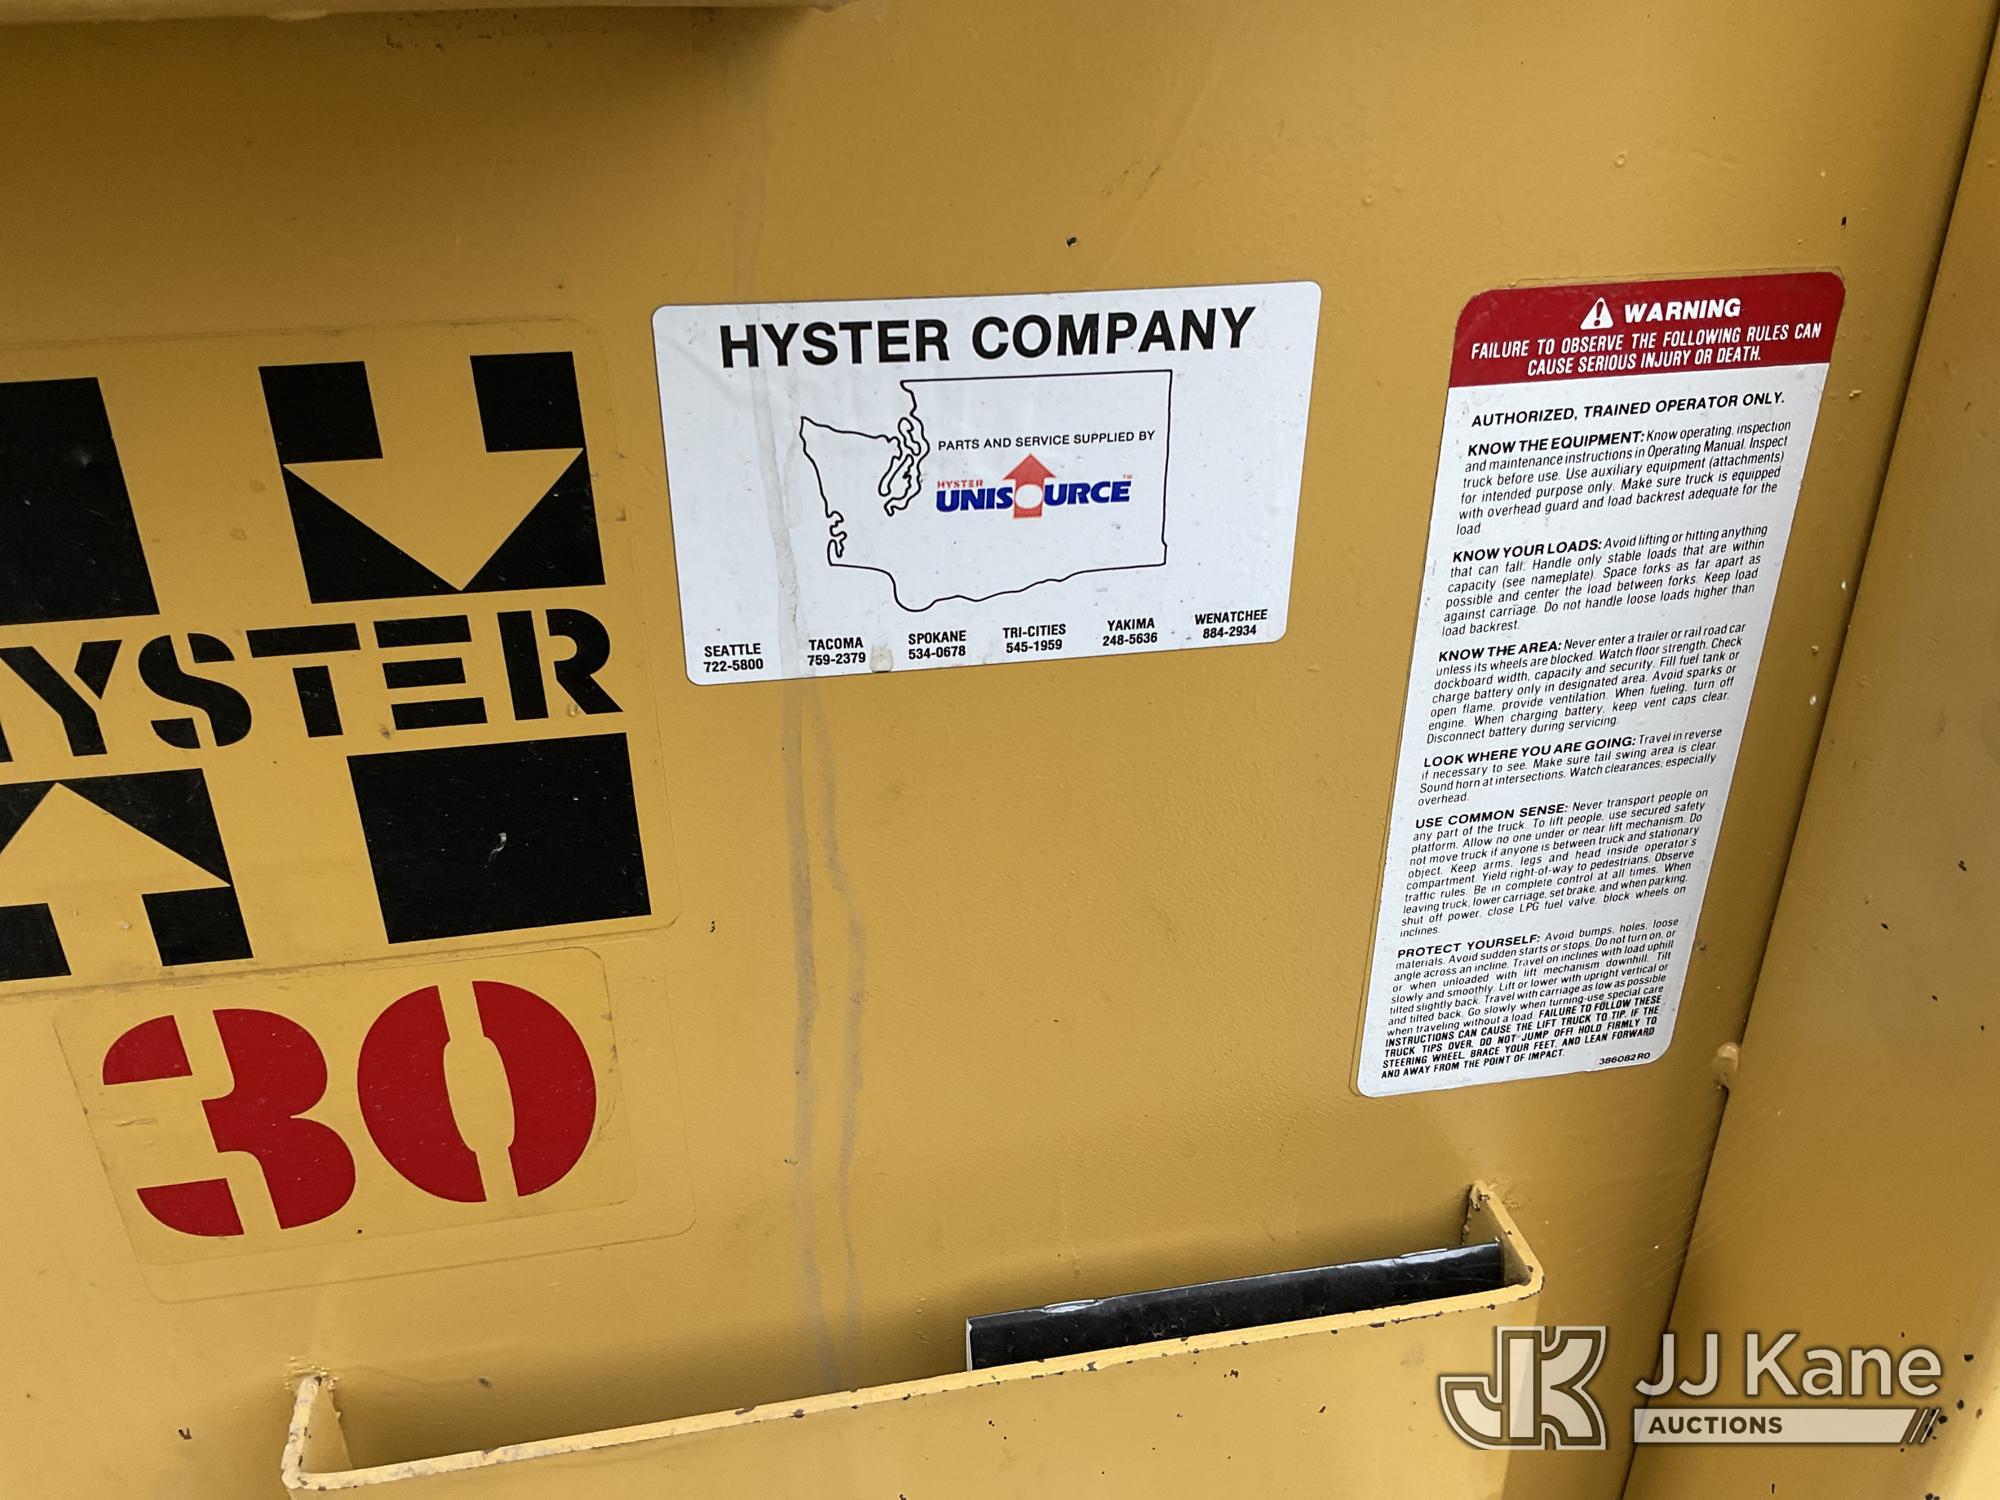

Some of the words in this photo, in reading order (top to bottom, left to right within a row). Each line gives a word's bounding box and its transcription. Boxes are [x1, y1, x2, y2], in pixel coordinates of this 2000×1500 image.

[1624, 297, 1741, 323] WARNING
[719, 318, 951, 369] HYSTER
[971, 306, 1257, 360] COMPANY
[1471, 339, 1530, 359] FAILURE
[1537, 338, 1555, 355] TO
[1560, 334, 1624, 354] OBSERVE
[1631, 332, 1657, 349] THE
[1662, 326, 1741, 347] FOLLOWING
[1746, 324, 1789, 342] RULES
[1794, 322, 1822, 339] CAN
[1527, 356, 1574, 376] CAUSE
[1577, 353, 1637, 373] SERIOUS
[1640, 349, 1691, 368] INJURY
[1694, 348, 1713, 365] OR
[1716, 345, 1761, 363] DEATH.
[1471, 407, 1577, 427] AUTHORIZED,
[1583, 401, 1651, 418] TRAINED
[1655, 394, 1738, 413] OPERATOR
[1742, 391, 1783, 406] ONLY.
[938, 440, 979, 451] PARTS
[983, 438, 1011, 449] AND
[1015, 435, 1070, 447] SERVICE
[1074, 431, 1135, 444] SUPPLIED
[1138, 430, 1155, 441] BY
[1467, 440, 1516, 457] KNOW
[1518, 437, 1549, 452] THE
[1550, 430, 1645, 450] EQUIPMENT:
[1646, 429, 1678, 442] Know
[1736, 420, 1791, 436] inspection
[936, 481, 1132, 512] UNISOURCE
[937, 480, 984, 489] HYSTER
[1460, 492, 1477, 504] for
[1481, 486, 1532, 502] intended
[1535, 484, 1583, 500] purpose
[1620, 476, 1652, 490] Make
[1656, 476, 1681, 488] sure
[1685, 471, 1714, 485] truck
[1717, 472, 1728, 482] is
[1731, 465, 1781, 483] equipped
[1458, 506, 1483, 520] with
[1487, 501, 1542, 518] overhead
[1544, 498, 1579, 515] guard
[1582, 495, 1604, 509] and
[1607, 493, 1633, 507] load
[1635, 489, 1685, 504] backrest
[1687, 485, 1739, 500] adequate
[1742, 483, 1758, 495] for
[1760, 481, 1778, 494] the
[1452, 547, 1500, 563] KNOW
[1502, 543, 1545, 558] YOUR
[1546, 538, 1602, 555] LOADS:
[1603, 535, 1637, 549] Avoid
[1638, 533, 1670, 547] lifting
[1671, 533, 1683, 543] or
[1684, 529, 1719, 542] hitting
[1720, 525, 1768, 540] anything
[1107, 617, 1155, 632] YAKIMA
[1194, 608, 1268, 626] WENATCHEE
[1441, 623, 1466, 636] load
[808, 637, 864, 651] TACOMA
[908, 630, 967, 645] SPOKANE
[1003, 624, 1067, 639] TRI-CITIES
[1102, 632, 1158, 647] 248-5636
[1202, 625, 1257, 639] 884-2934
[1438, 647, 1485, 662] KNOW
[1487, 644, 1517, 657] THE
[1517, 640, 1562, 655] AREA:
[1563, 638, 1596, 650] Never
[1597, 635, 1626, 647] enter
[1627, 634, 1635, 644] a
[1636, 630, 1669, 643] trailer
[1670, 630, 1682, 639] or
[1683, 625, 1702, 638] rail
[1703, 623, 1728, 636] road
[1728, 623, 1746, 634] car
[704, 643, 761, 658] SEATTLE
[807, 652, 866, 667] 759-2379
[908, 645, 967, 660] 534-0678
[1006, 639, 1063, 654] 545-1959
[703, 658, 764, 673] 722-5800
[0, 607, 622, 762] YSTER
[1432, 692, 1470, 704] charge
[1473, 687, 1513, 700] battery
[1516, 683, 1541, 696] only
[1544, 683, 1555, 692] in
[1558, 674, 1619, 691] designated
[1651, 668, 1684, 681] Avoid
[1686, 664, 1722, 679] sparks
[1725, 665, 1736, 674] or
[1426, 728, 1485, 744] Disconnect
[1488, 726, 1527, 738] battery
[1530, 722, 1565, 733] during
[1423, 753, 1464, 768] LOOK
[1466, 747, 1518, 763] WHERE
[1521, 744, 1552, 757] YOU
[1552, 741, 1582, 754] ARE
[1584, 736, 1636, 751] GOING:
[1639, 732, 1671, 744] Travel
[1672, 732, 1682, 741] in
[1684, 728, 1722, 740] reverse
[1415, 816, 1443, 829] USE
[1447, 808, 1515, 825] COMMON
[1518, 803, 1568, 818] SENSE:
[1572, 800, 1603, 811] Never
[1606, 793, 1655, 808] transport
[1657, 789, 1692, 804] people
[1695, 789, 1708, 798] on
[1409, 855, 1426, 866] not
[1429, 853, 1458, 863] move
[1460, 848, 1487, 860] truck
[1490, 846, 1498, 857] if
[1499, 844, 1539, 857] anyone
[1540, 843, 1550, 851] is
[1552, 838, 1596, 850] between
[1598, 833, 1625, 845] truck
[1626, 830, 1647, 842] and
[1648, 826, 1700, 839] stationary
[1397, 942, 1462, 959] PROTECT
[1466, 933, 1540, 951] YOURSELF:
[1544, 929, 1574, 942] Avoid
[1652, 918, 1679, 928] loose
[1392, 985, 1402, 993] or
[1409, 981, 1437, 990] when
[1442, 973, 1489, 987] unloaded
[1495, 970, 1517, 980] with
[1523, 967, 1537, 977] lift
[1543, 961, 1600, 975] mechanism
[1657, 950, 1671, 961] Tilt
[1380, 1068, 1400, 1079] AND
[1402, 1064, 1431, 1076] AWAY
[1433, 1061, 1460, 1072] FROM
[1463, 1058, 1480, 1069] THE
[1483, 1054, 1511, 1067] POINT
[1513, 1053, 1525, 1063] OF
[102, 980, 596, 1236] 30
